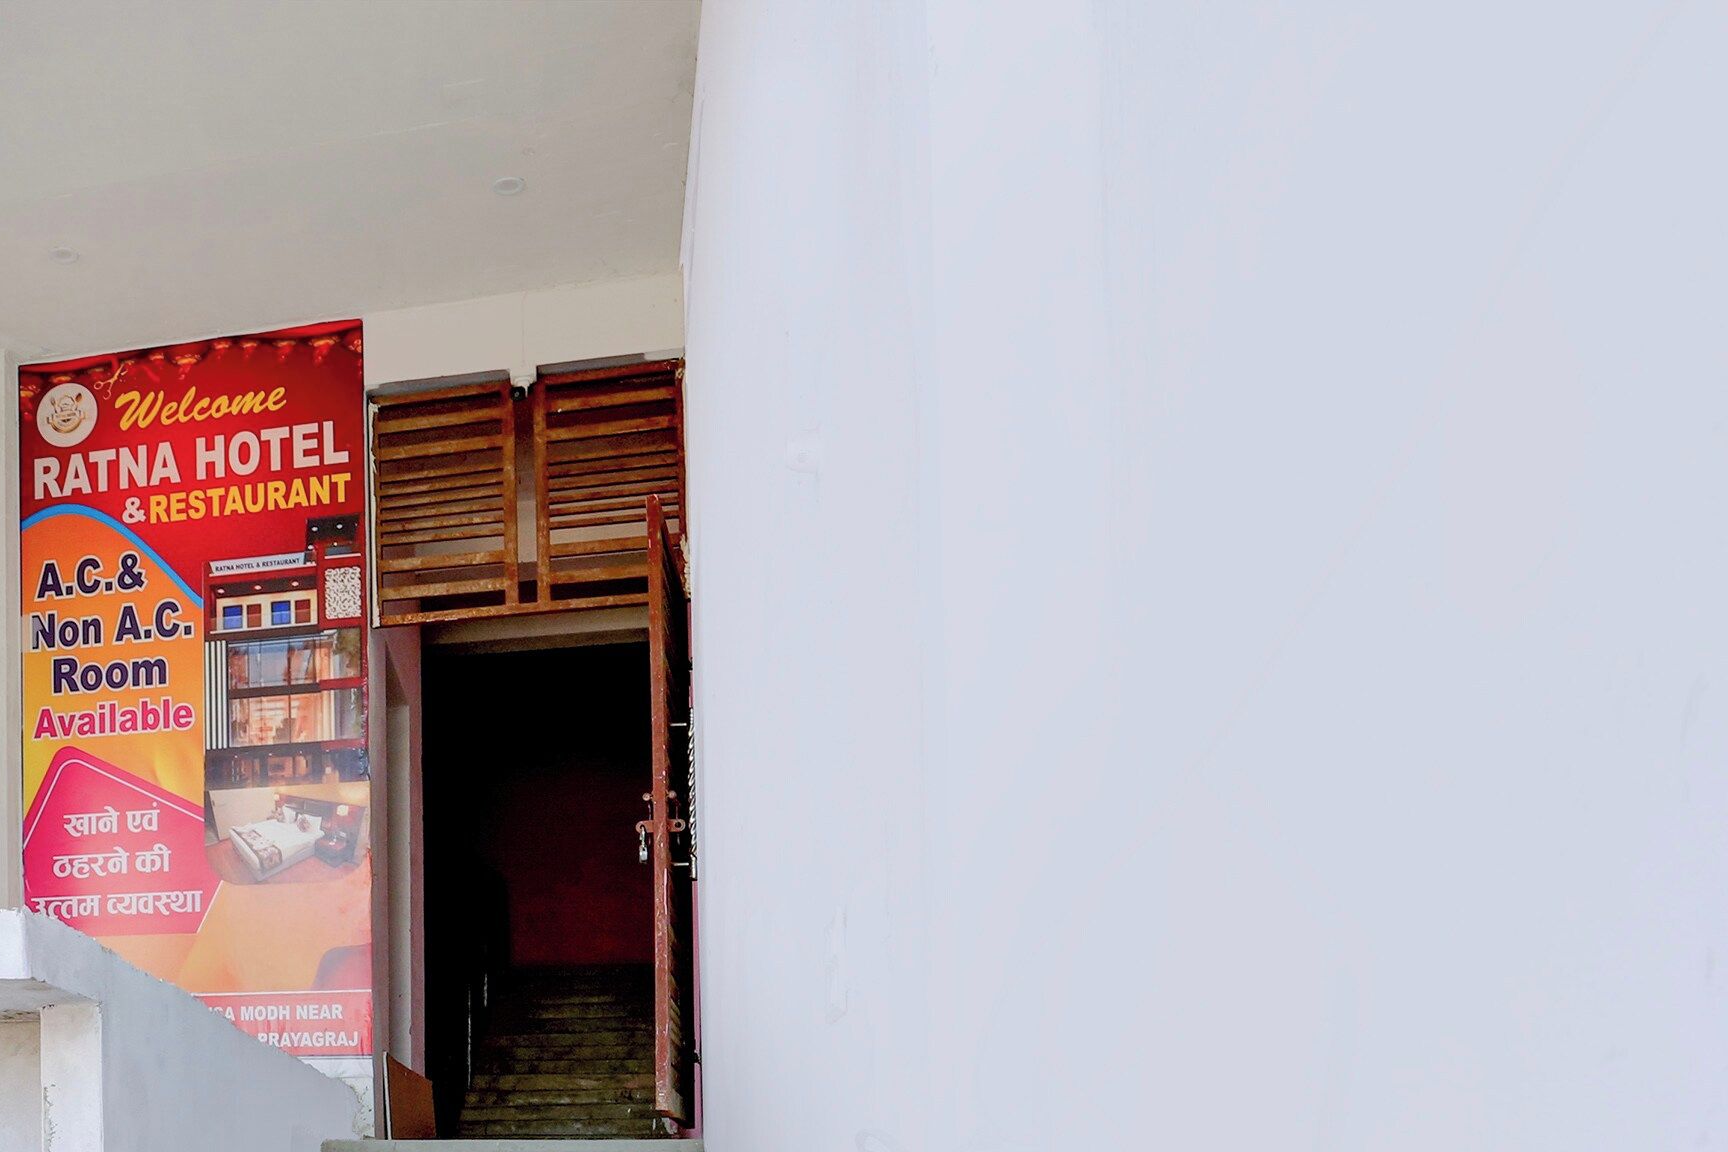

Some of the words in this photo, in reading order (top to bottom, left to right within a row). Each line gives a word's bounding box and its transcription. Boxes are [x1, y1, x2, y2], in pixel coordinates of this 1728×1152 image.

[114, 386, 287, 431] Welcome
[33, 440, 181, 500] RATNA
[195, 420, 350, 480] HOTEL
[215, 564, 235, 572] RATNA
[236, 562, 255, 571] HOTEL
[262, 557, 301, 567] RESTAURANT
[31, 611, 103, 652] Non
[113, 599, 195, 644] A.C.
[51, 656, 169, 696] Room
[32, 696, 196, 740] Available
[63, 805, 120, 837] खाने
[125, 801, 160, 833] एवं
[52, 846, 130, 879] ठहरने
[135, 843, 172, 873] की
[106, 890, 203, 916] व्यवस्था
[240, 1005, 291, 1021] MODH
[296, 1004, 344, 1020] NEAR
[257, 1031, 359, 1048] PRAYAGRAJ
